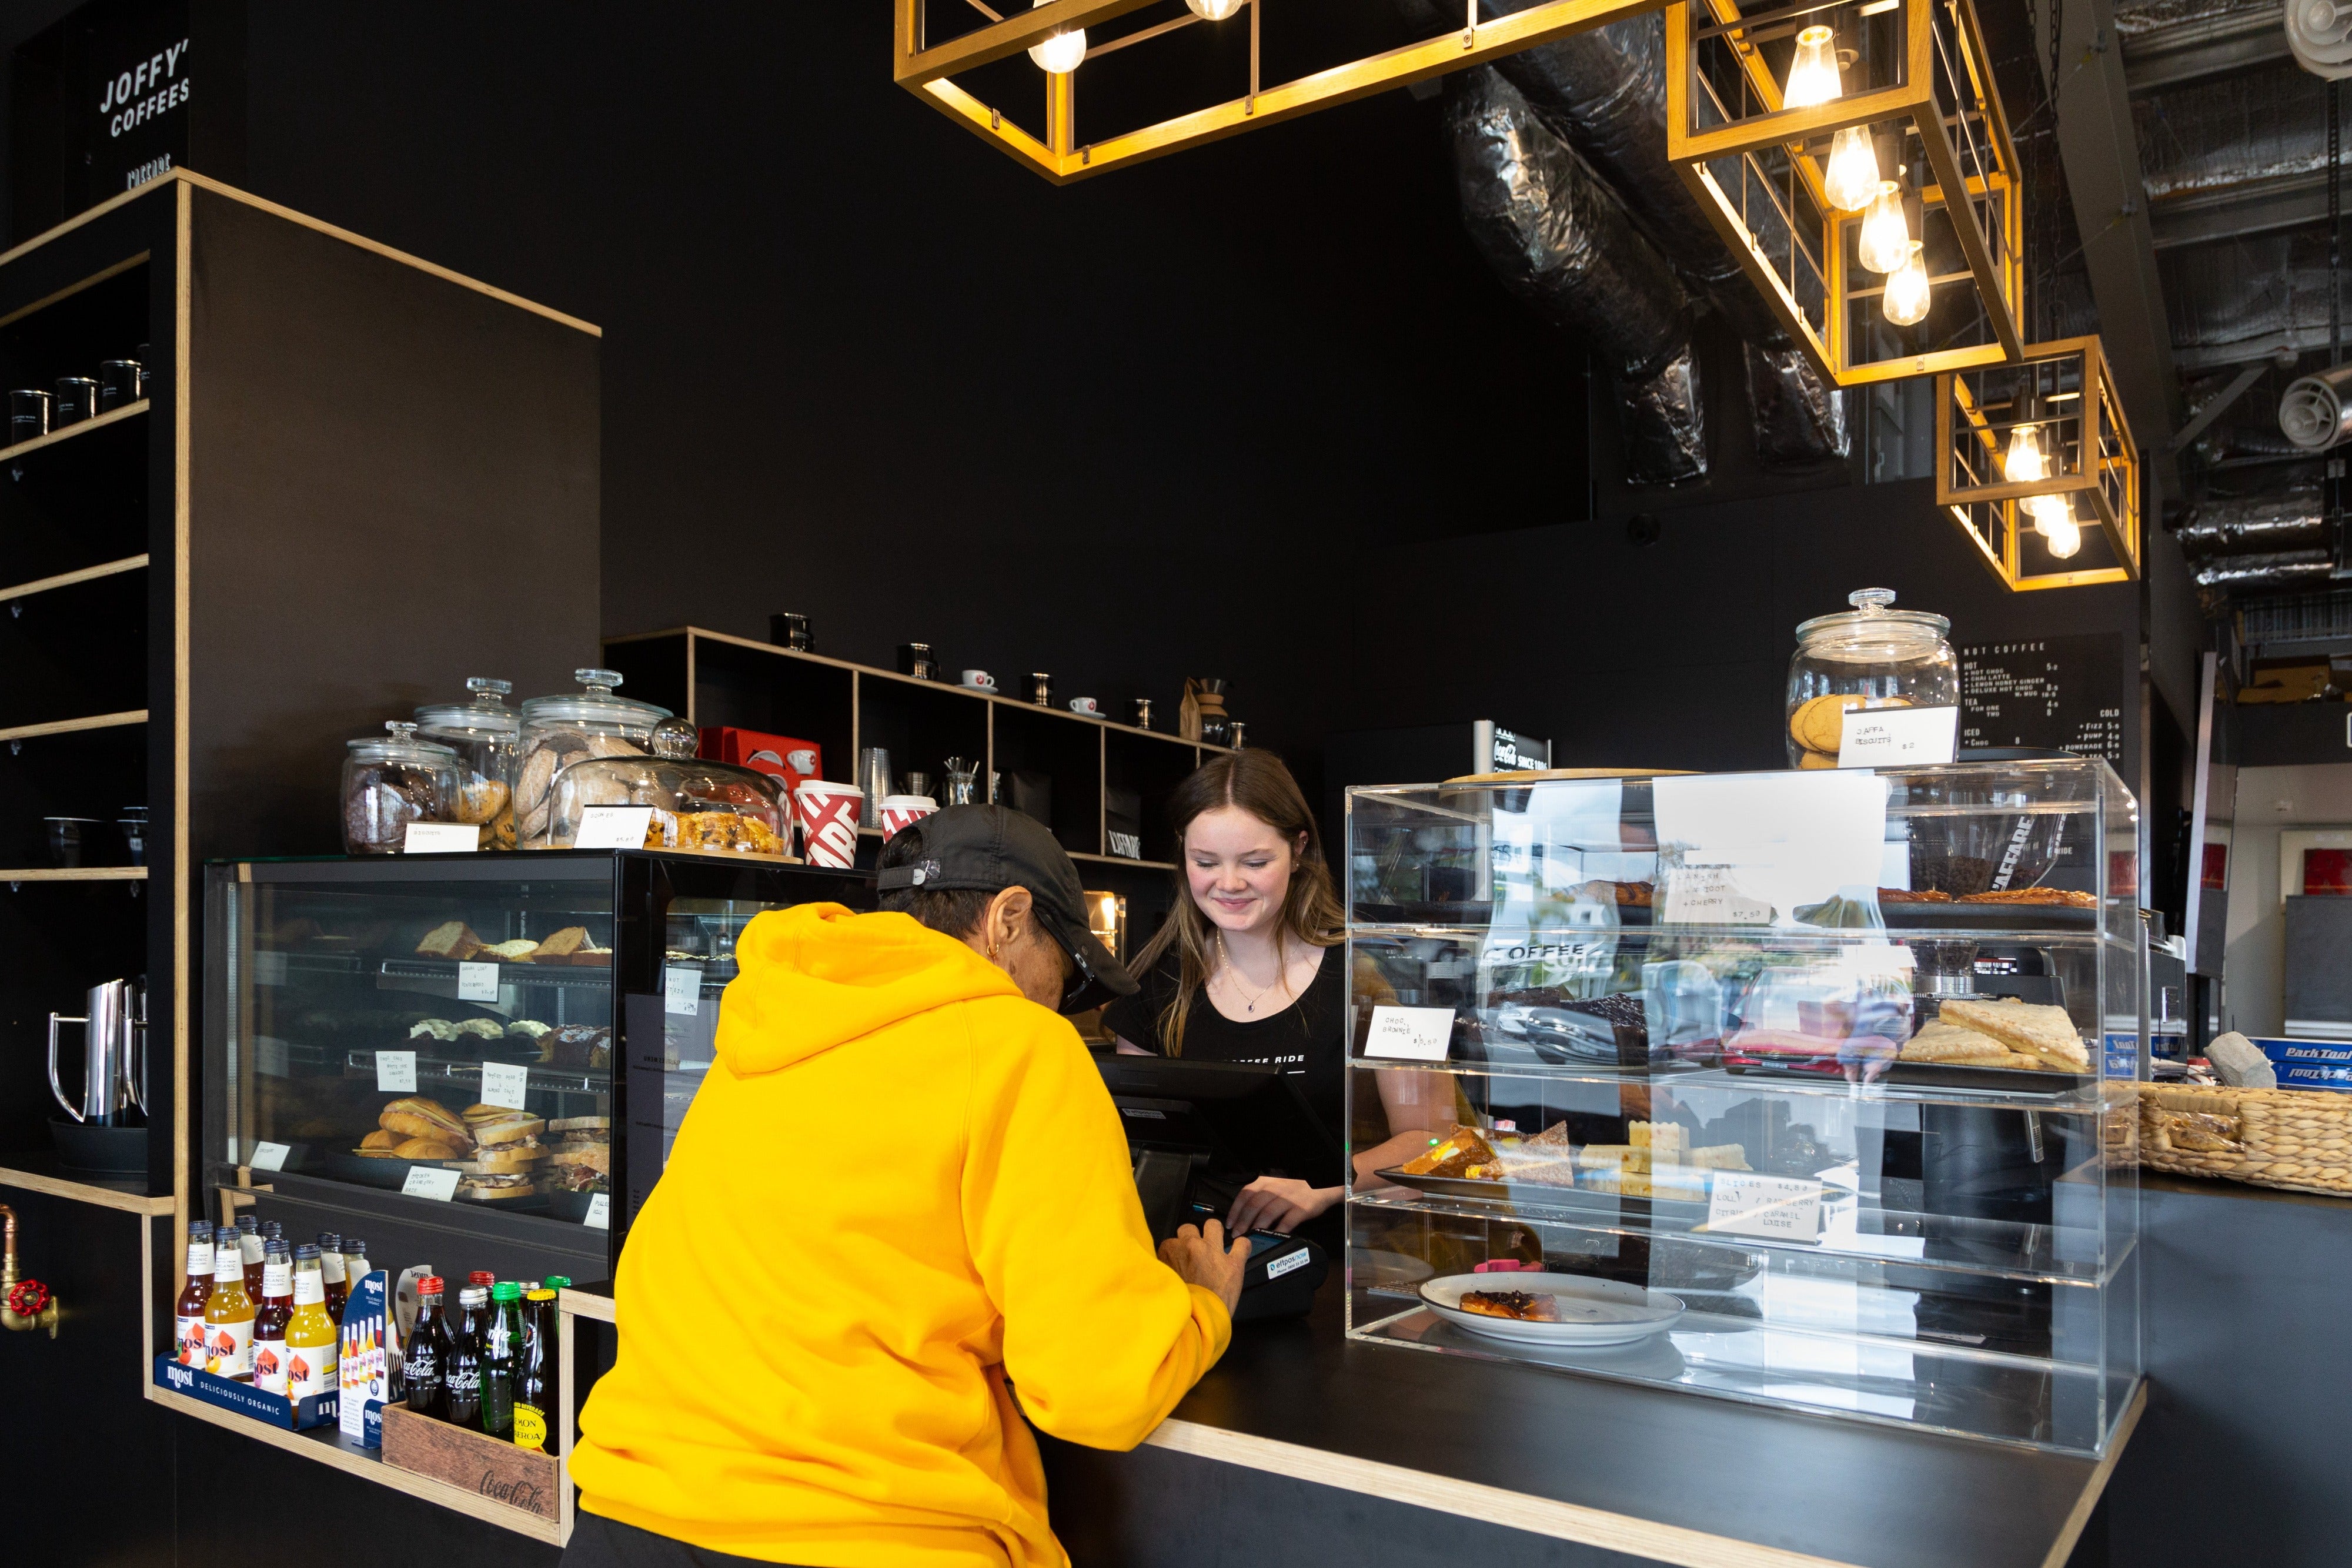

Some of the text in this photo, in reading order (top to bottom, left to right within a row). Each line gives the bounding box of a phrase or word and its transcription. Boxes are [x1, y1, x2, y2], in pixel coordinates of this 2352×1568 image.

[111, 78, 189, 138] COFFEES
[1964, 643, 2044, 656] NOT COFFEE
[2100, 708, 2119, 717] COLD
[1857, 727, 1884, 735] JAFFA
[1964, 728, 1980, 737] ICED
[1855, 737, 1891, 745] BISCUITS
[2065, 743, 2103, 751] POWERADE
[1518, 755, 1534, 770] SINCE
[1275, 1055, 1304, 1064] RIDE
[1720, 1178, 1761, 1188] SLICES
[1764, 1219, 1792, 1228] LOUISE
[365, 1279, 383, 1294] most
[167, 1365, 194, 1389] most
[200, 1381, 280, 1415] DELICIOUSLY ORGANIC
[479, 1470, 544, 1515] Coca-Cola
